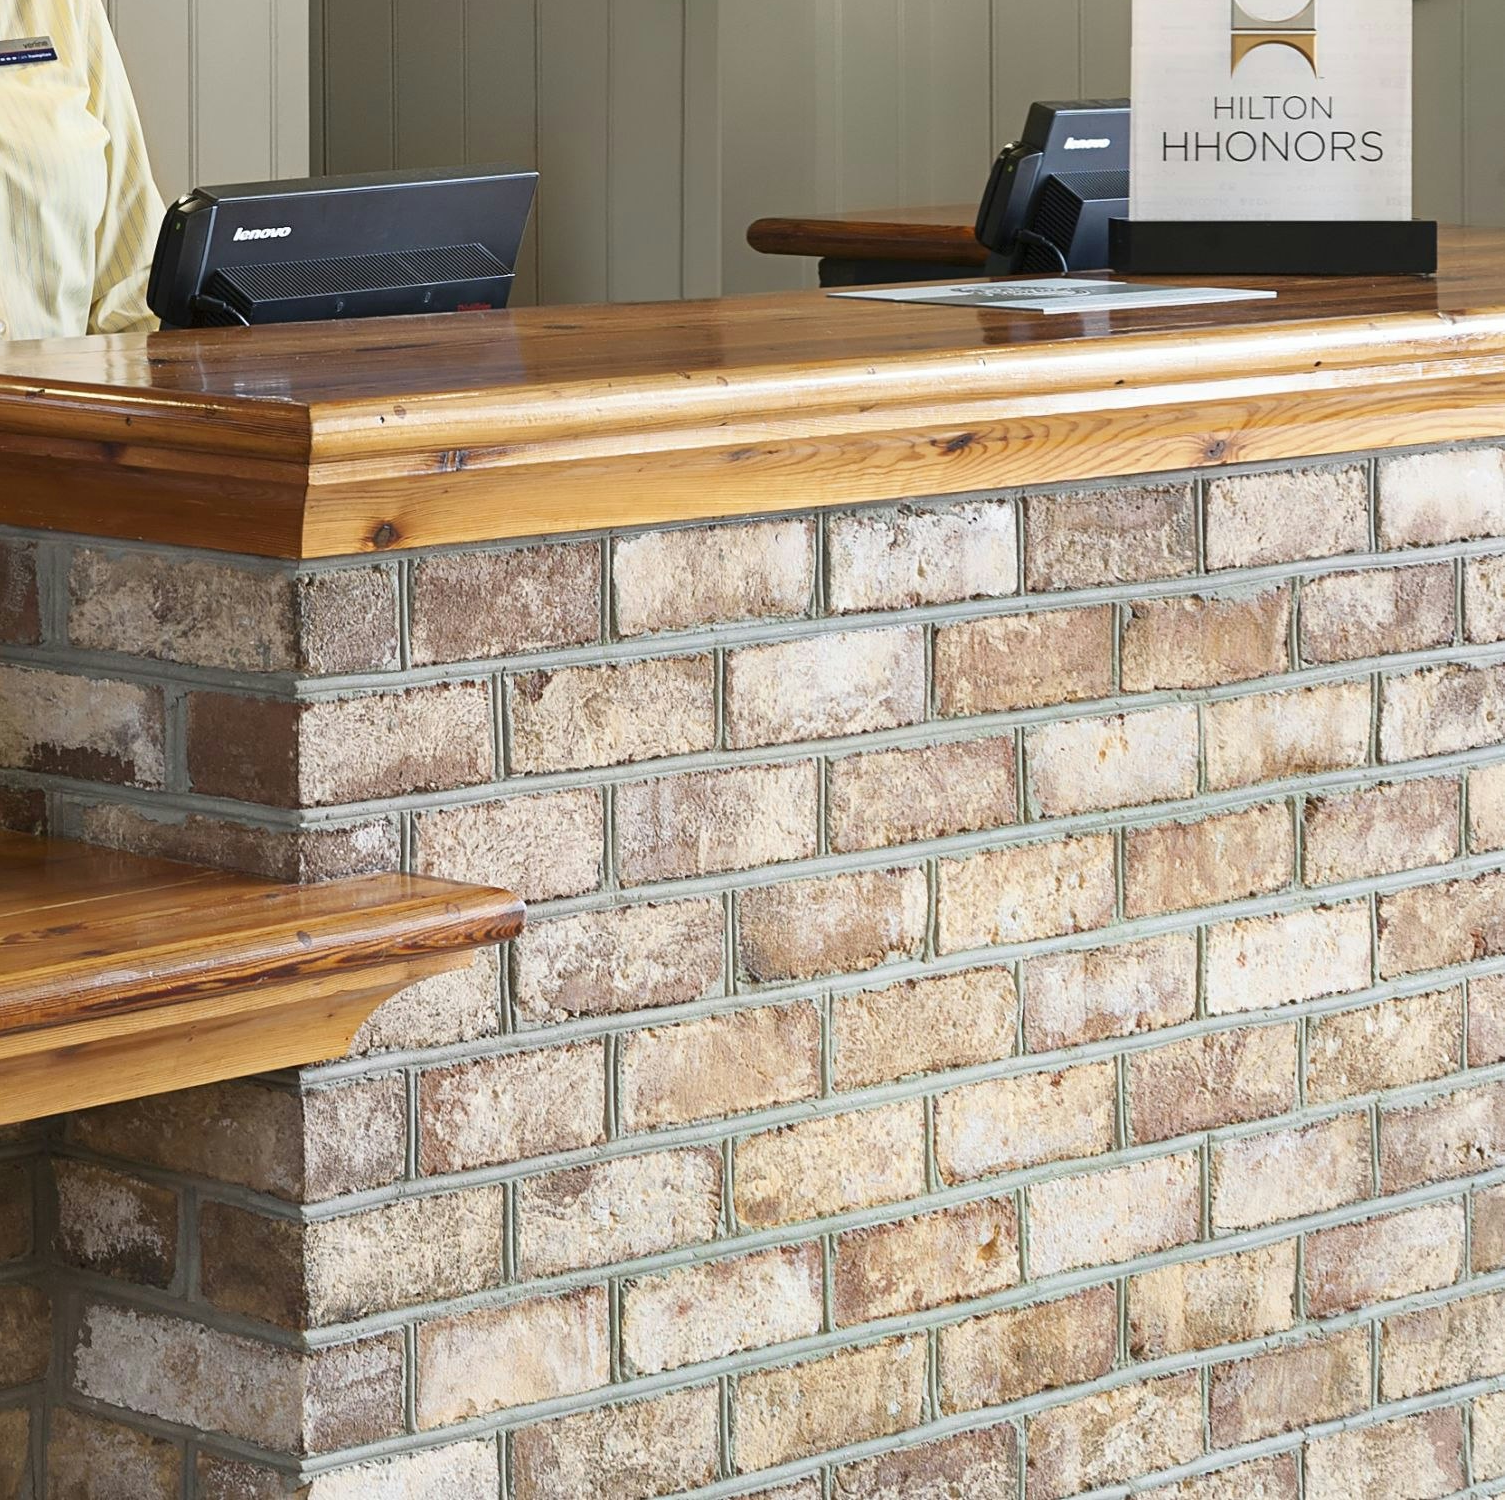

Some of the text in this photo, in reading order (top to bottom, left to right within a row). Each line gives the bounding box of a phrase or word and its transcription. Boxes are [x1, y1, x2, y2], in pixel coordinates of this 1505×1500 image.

[1214, 95, 1333, 120] HILTON
[1162, 130, 1384, 162] HHONORS
[233, 225, 292, 241] lenovo
